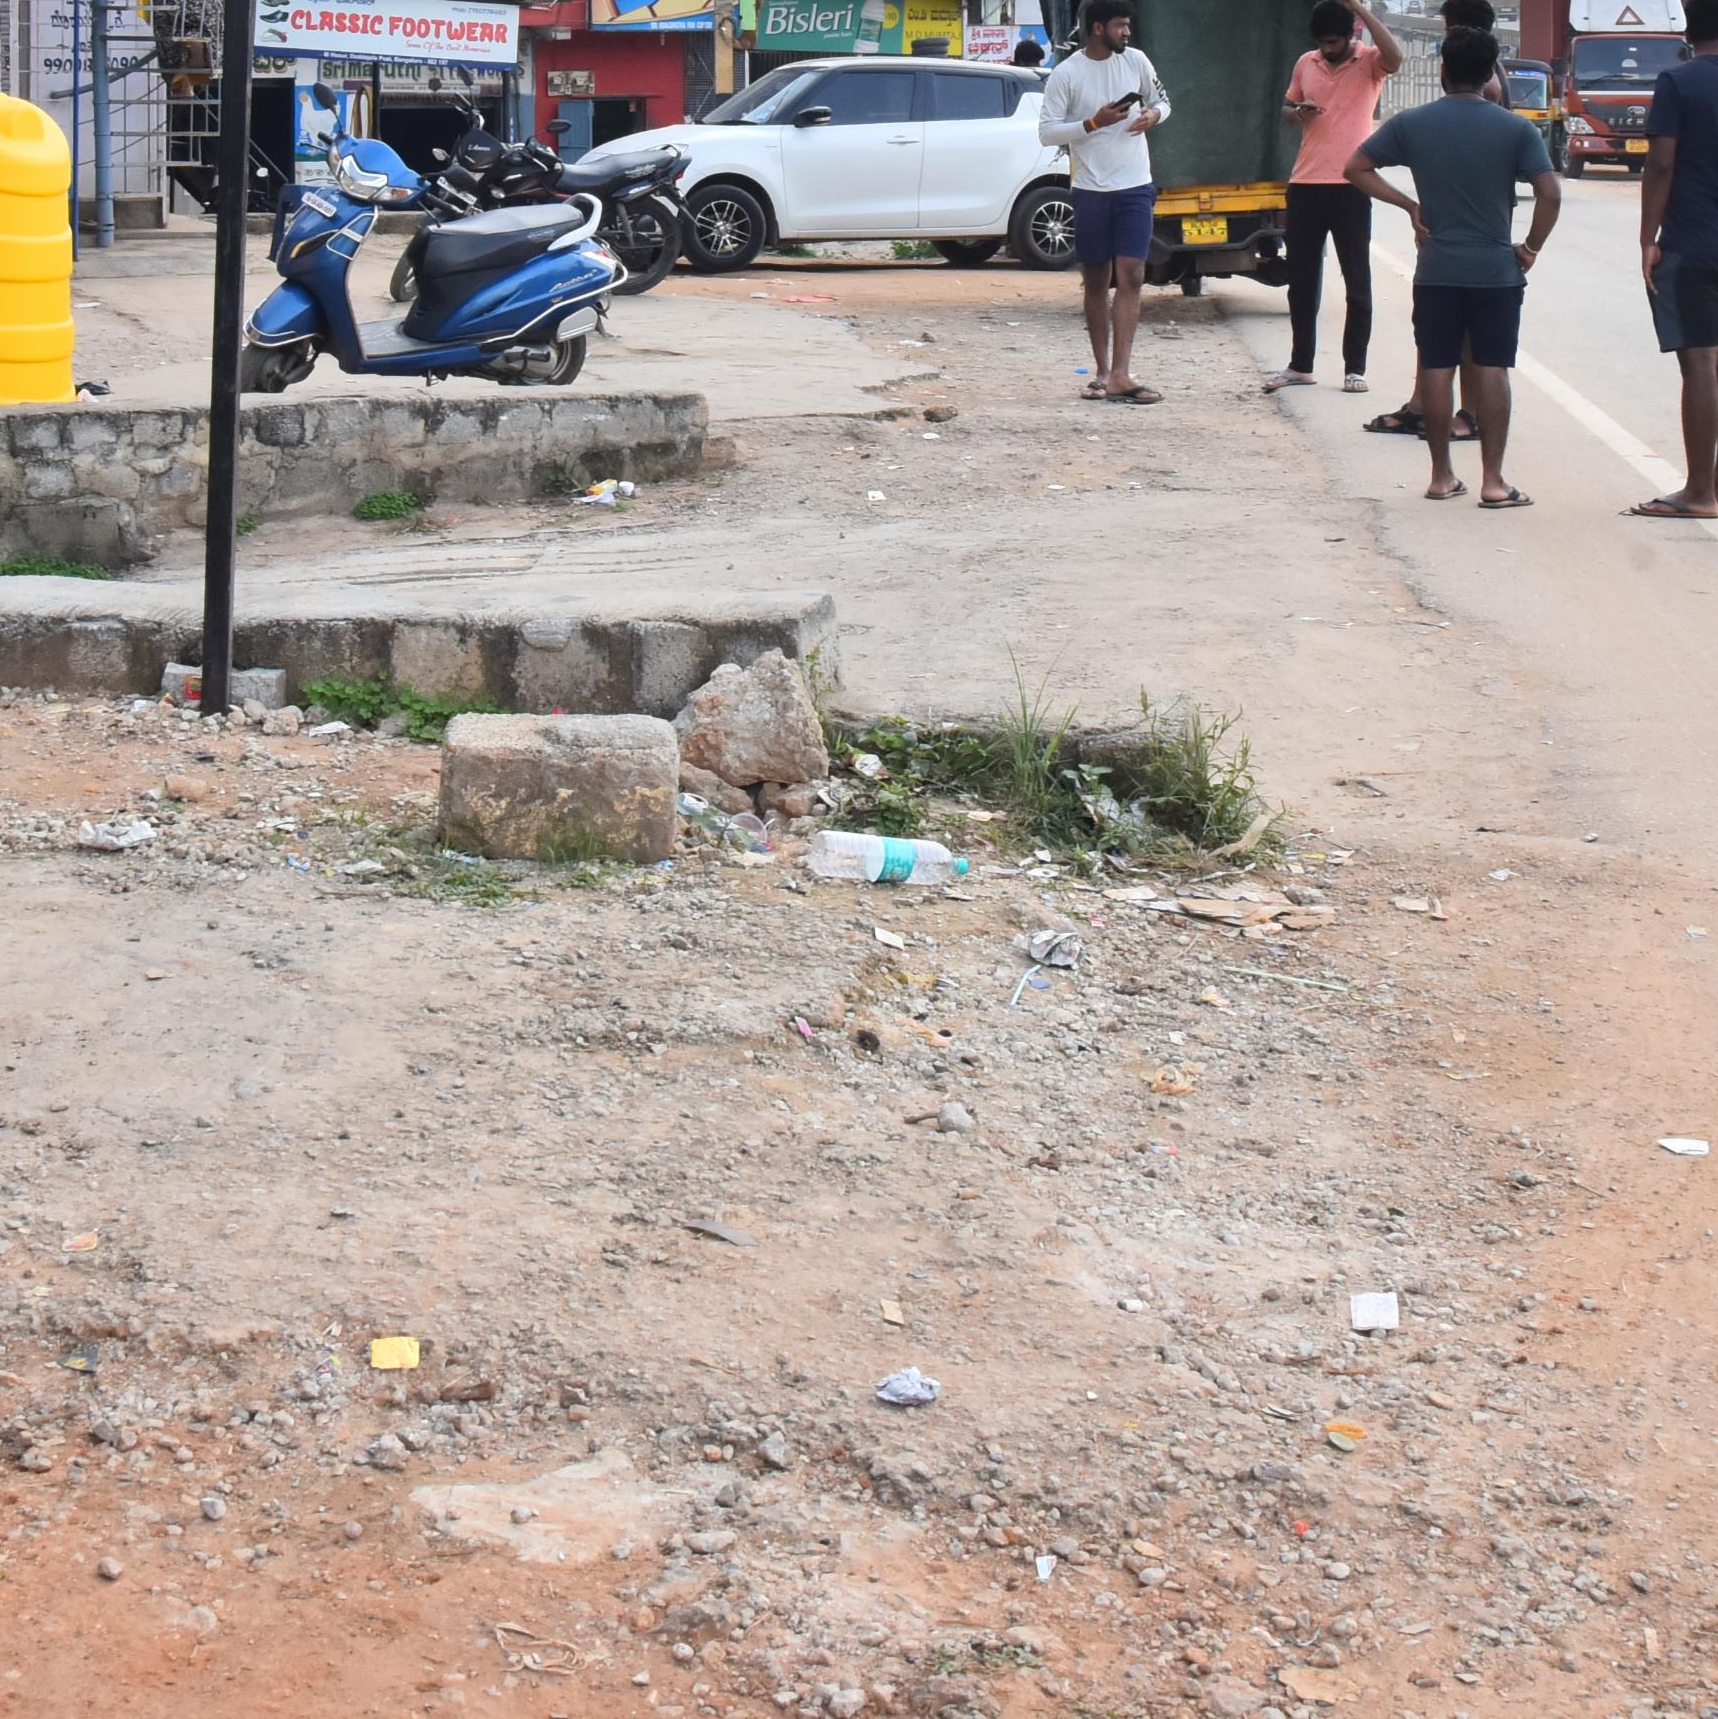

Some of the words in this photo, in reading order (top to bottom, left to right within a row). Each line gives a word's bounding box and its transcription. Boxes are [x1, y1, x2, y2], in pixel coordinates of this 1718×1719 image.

[290, 9, 384, 35] CLASSIC
[388, 15, 508, 44] FOOTWEAR
[765, 2, 855, 36] Bisleri
[348, 60, 421, 81] Mauthi
